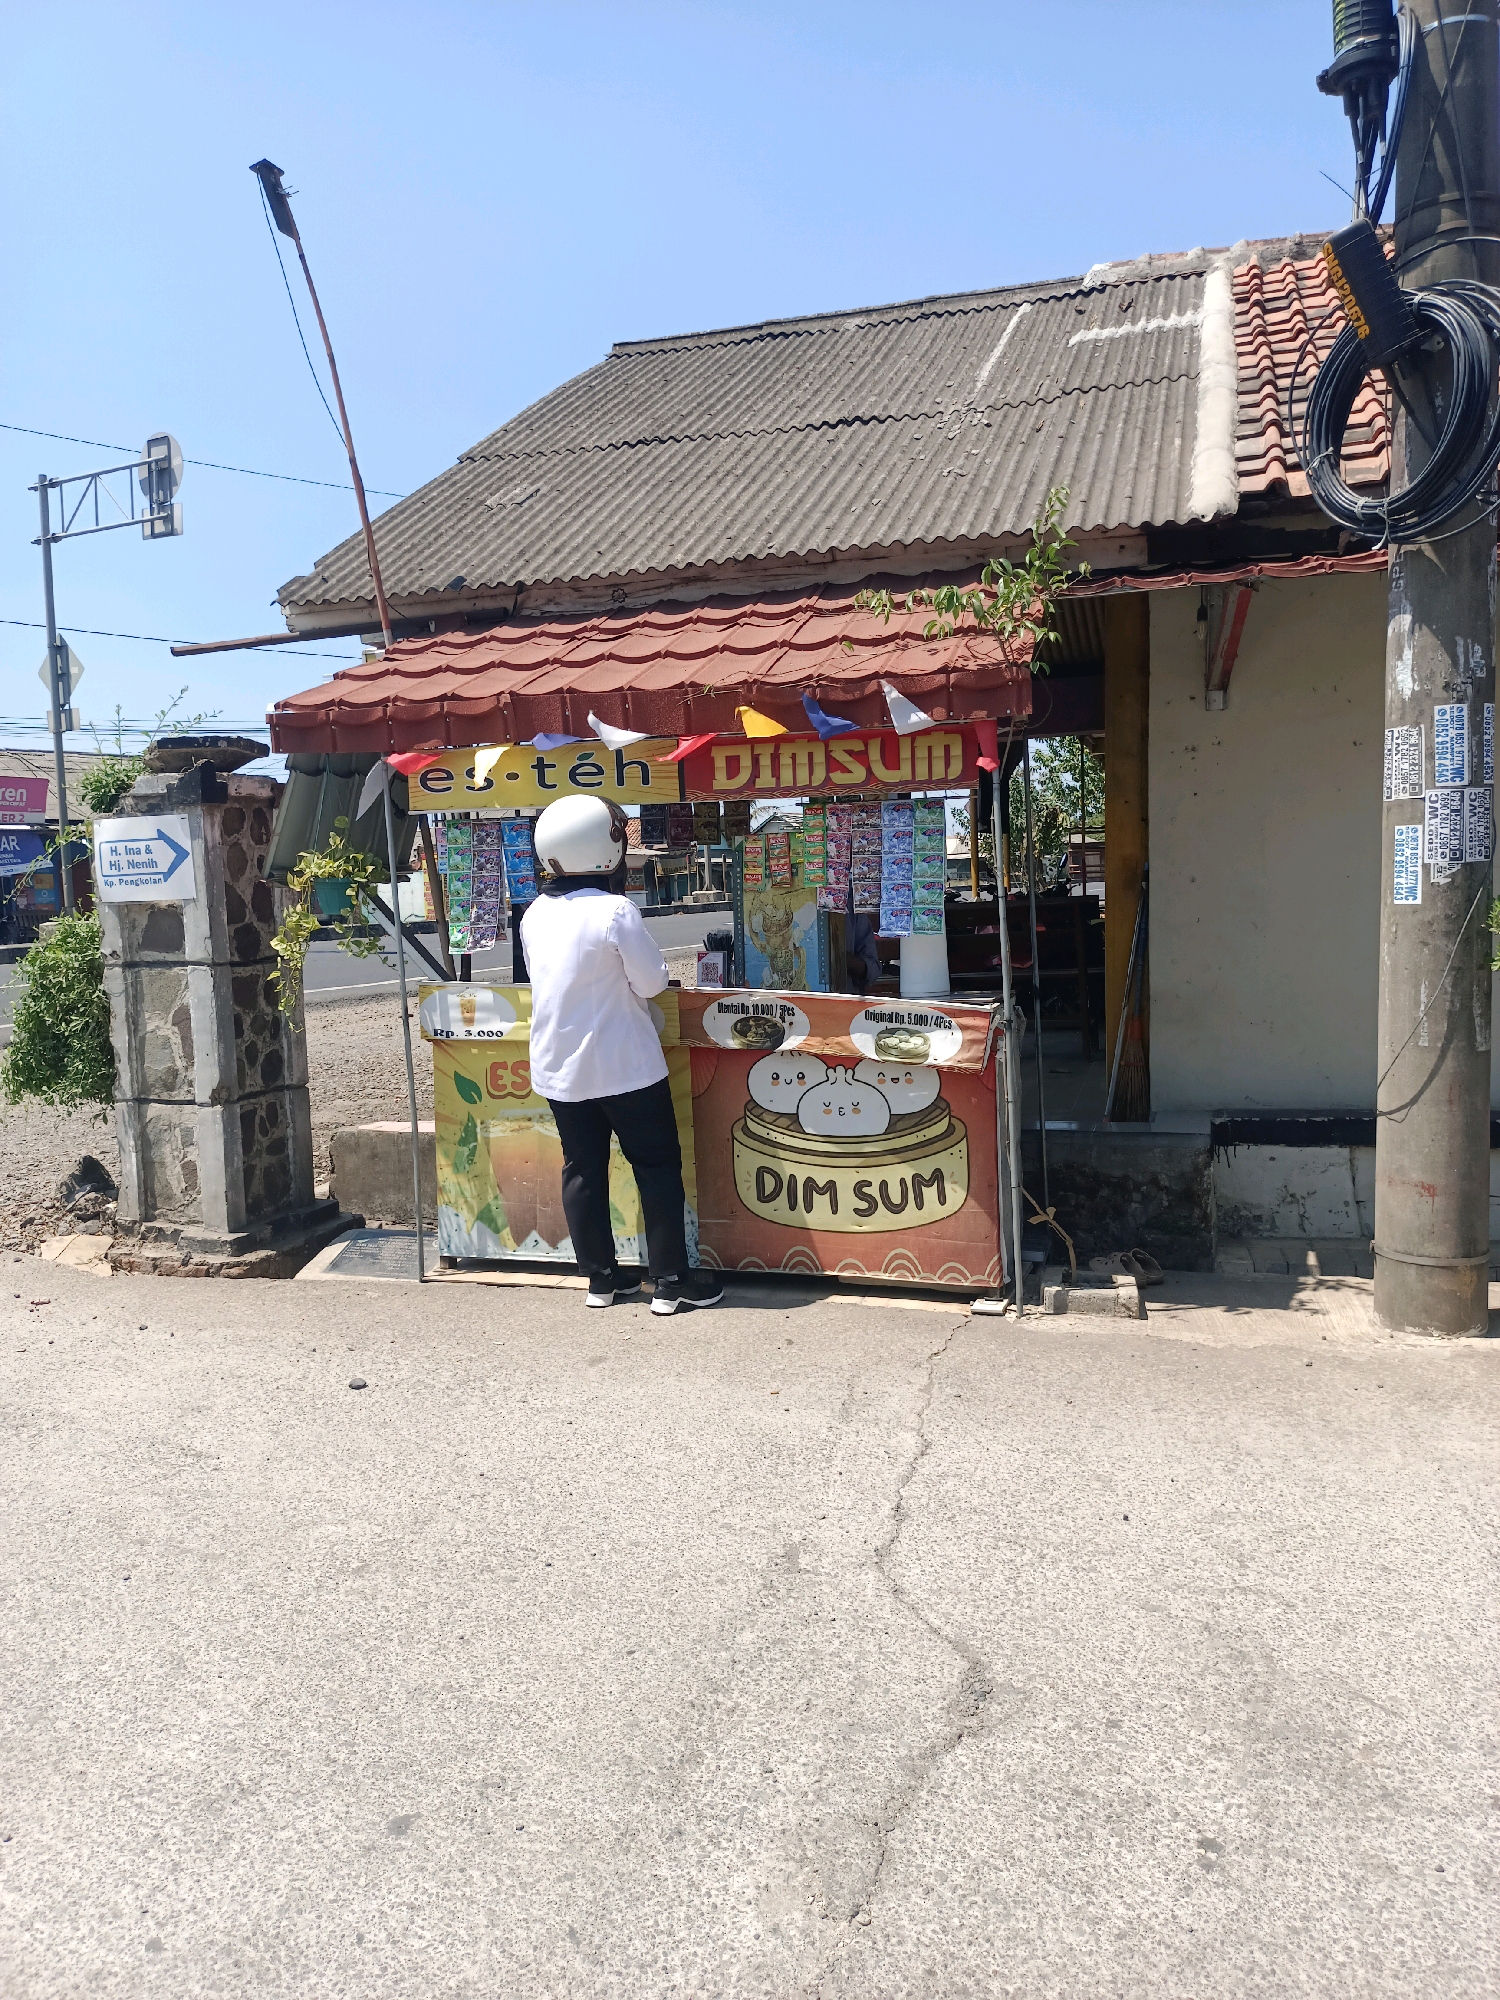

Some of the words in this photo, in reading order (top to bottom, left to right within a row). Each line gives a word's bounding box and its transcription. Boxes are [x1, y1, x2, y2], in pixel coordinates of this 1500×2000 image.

[1436, 719, 1449, 738] 0852
[1455, 715, 1464, 730] 0878
[1455, 733, 1464, 748] 8531
[1436, 741, 1449, 760] 9594
[1455, 751, 1464, 766] 9777
[711, 731, 963, 790] DIMSUM
[1436, 763, 1449, 783] 4543
[1450, 767, 1464, 782] WC
[1429, 794, 1439, 820] WC
[1440, 793, 1449, 810] 0692
[1469, 791, 1477, 819] WC
[19, 814, 25, 822] 2
[1440, 813, 1449, 829] 1782
[1450, 812, 1460, 829] 2321
[1396, 838, 1404, 857] 0852
[1440, 832, 1449, 849] 0857
[1450, 831, 1460, 849] 0812
[110, 845, 122, 857] H.
[124, 845, 142, 856] Ina
[144, 844, 153, 855] &
[109, 860, 124, 872] Hj.
[127, 858, 158, 870] Nenih
[103, 879, 116, 888] Kp.
[118, 877, 163, 886] Pengkolan
[1404, 886, 1418, 901] WC
[717, 1002, 741, 1015] Mentai
[751, 1003, 774, 1016] 10.000
[779, 1005, 796, 1018] 5Pcs
[864, 1009, 894, 1024] Original
[894, 1012, 906, 1025] Rp.
[907, 1013, 929, 1026] 5.000
[933, 1015, 953, 1030] 4Pcs
[433, 1028, 459, 1039] Rp.
[464, 1029, 504, 1038] 3.000
[489, 1059, 531, 1093] ES
[755, 1165, 839, 1216] DIM
[852, 1167, 947, 1218] SUM
